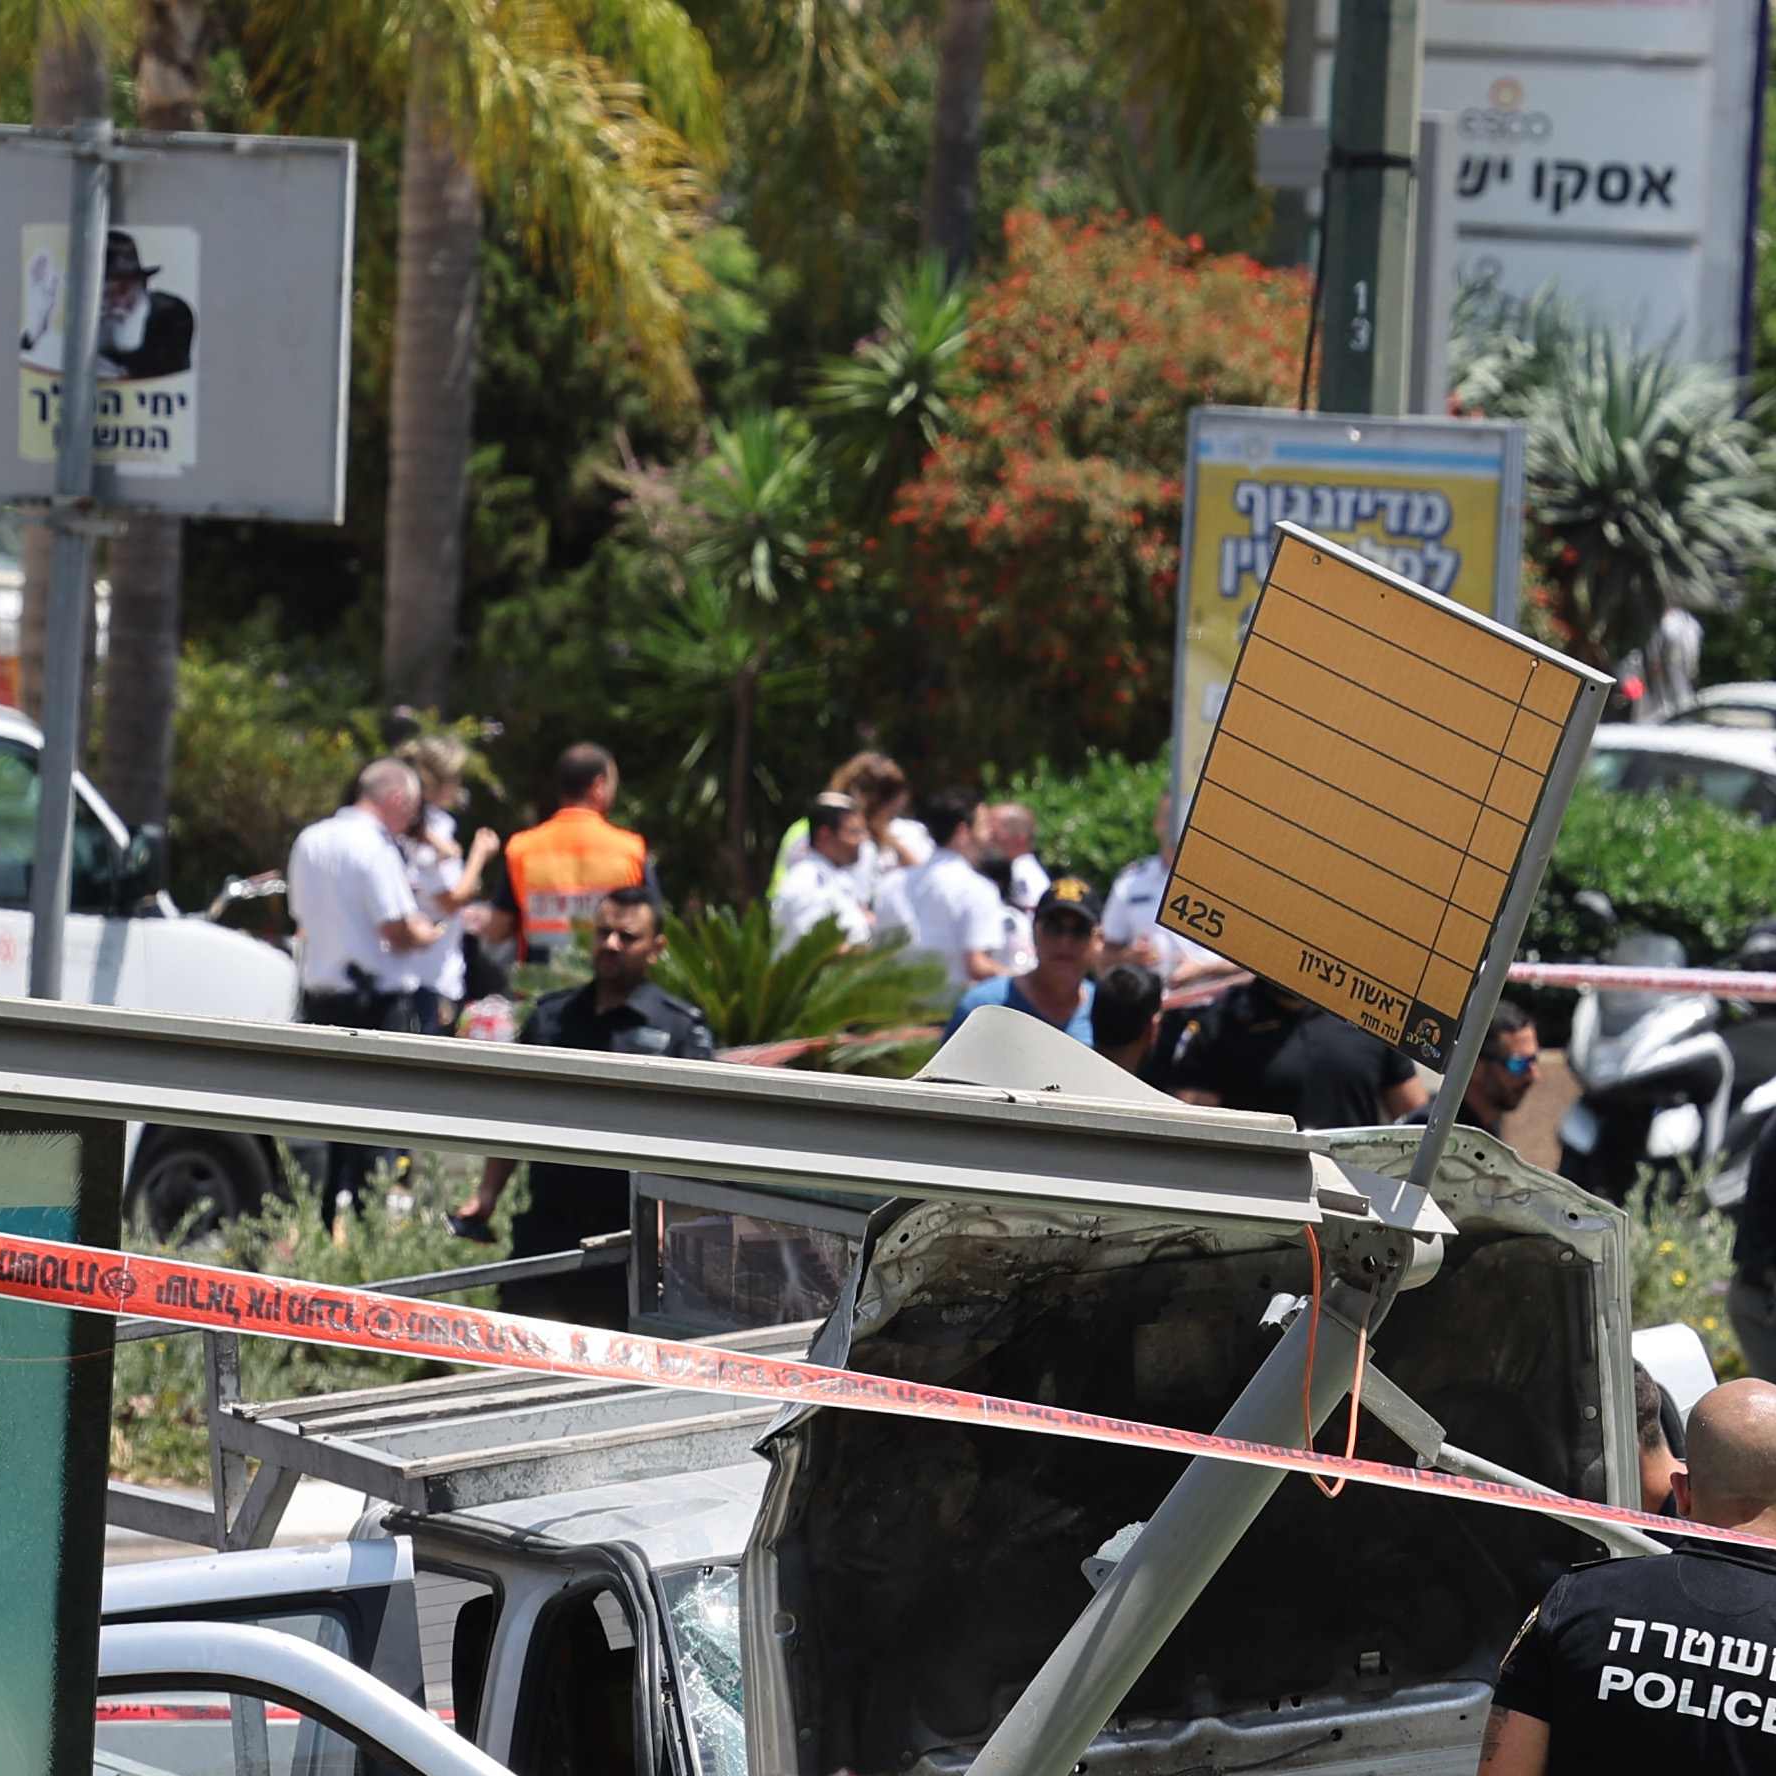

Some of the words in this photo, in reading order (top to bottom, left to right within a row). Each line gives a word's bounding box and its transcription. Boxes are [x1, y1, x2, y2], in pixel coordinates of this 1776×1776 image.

[1530, 156, 1675, 214] אסקו
[136, 391, 187, 416] יחי
[1169, 893, 1225, 938] 425
[1298, 949, 1348, 988] לציון
[1349, 976, 1408, 1023] ראשון
[1359, 1011, 1380, 1034] חוף
[1380, 1021, 1400, 1041] נוה
[156, 1275, 241, 1323] ישראל
[247, 1285, 281, 1322] אין
[288, 1291, 359, 1334] מעבר
